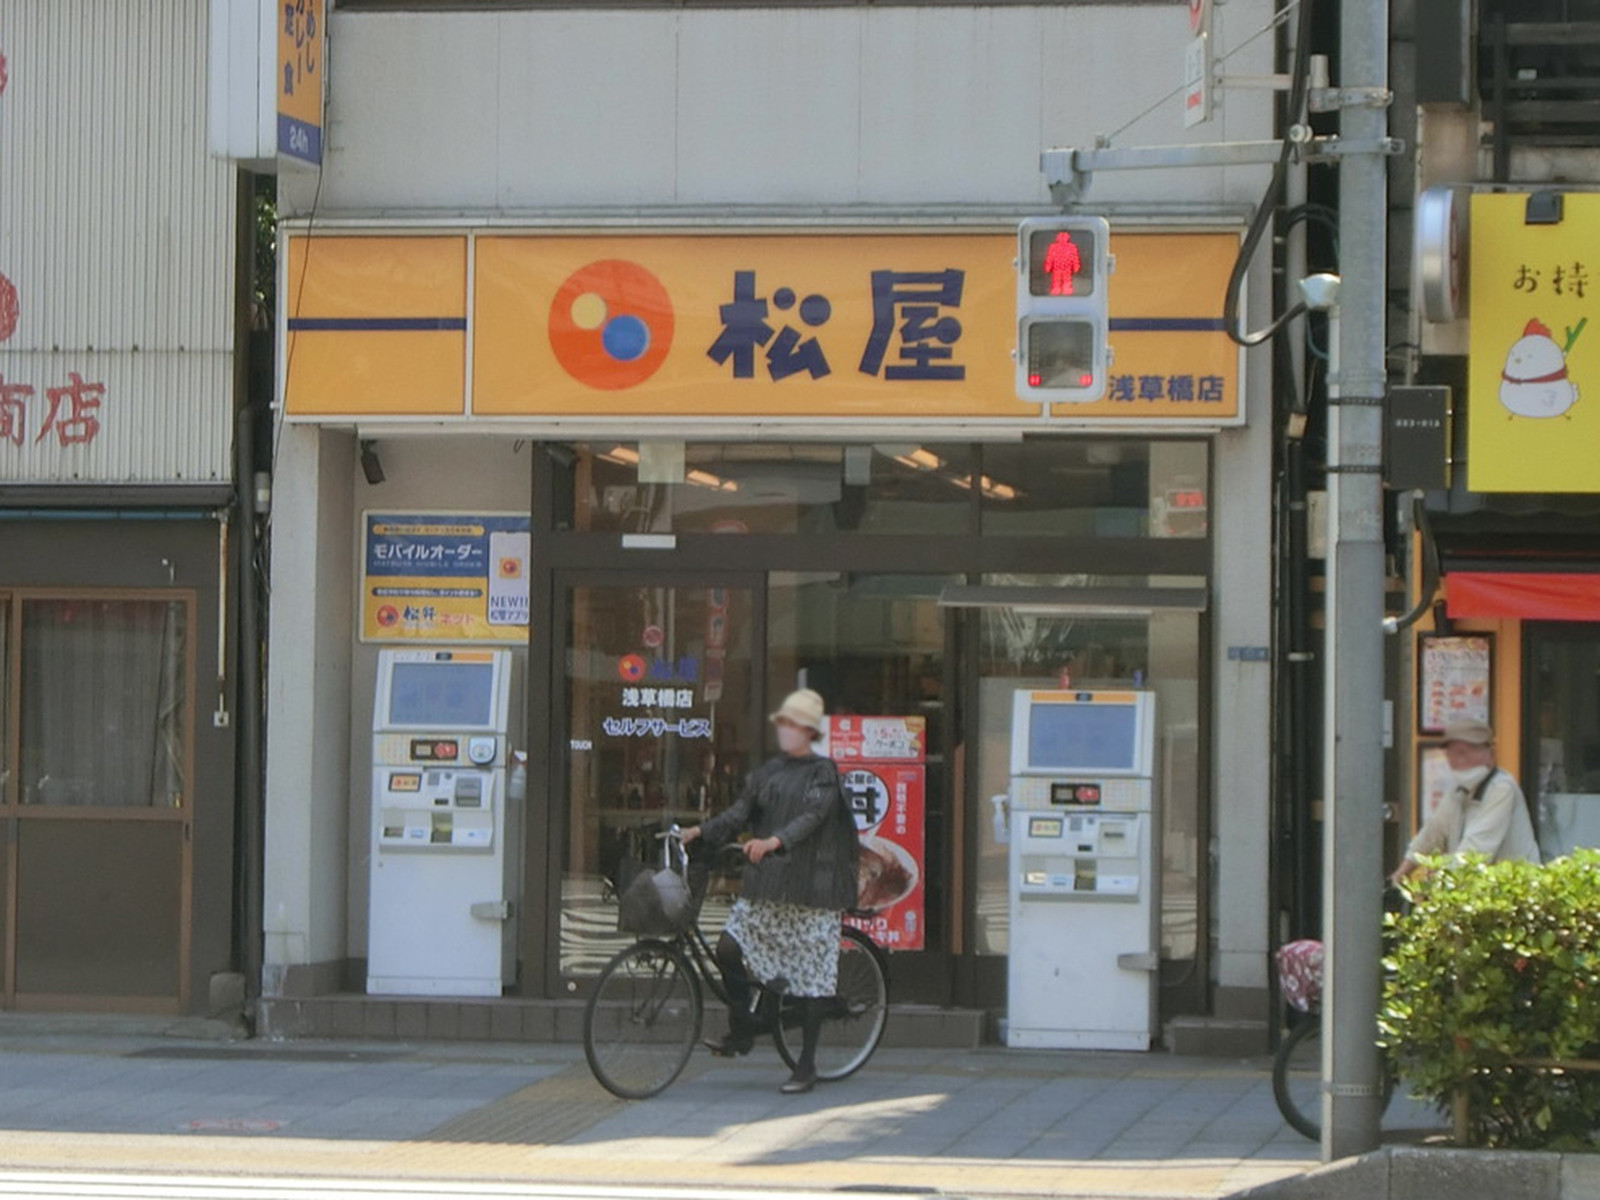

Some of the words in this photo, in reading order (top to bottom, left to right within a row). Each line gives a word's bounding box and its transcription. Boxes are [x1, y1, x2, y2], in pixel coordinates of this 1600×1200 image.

[306, 0, 316, 74] めし
[289, 125, 309, 153] 24h
[1512, 261, 1600, 298] お持
[707, 268, 966, 382] 松屋
[1108, 375, 1225, 403] 浅草橋店
[373, 543, 484, 560] モバイルオーダー
[621, 687, 694, 708] 浅草橋店
[602, 716, 712, 737] セルフサービス
